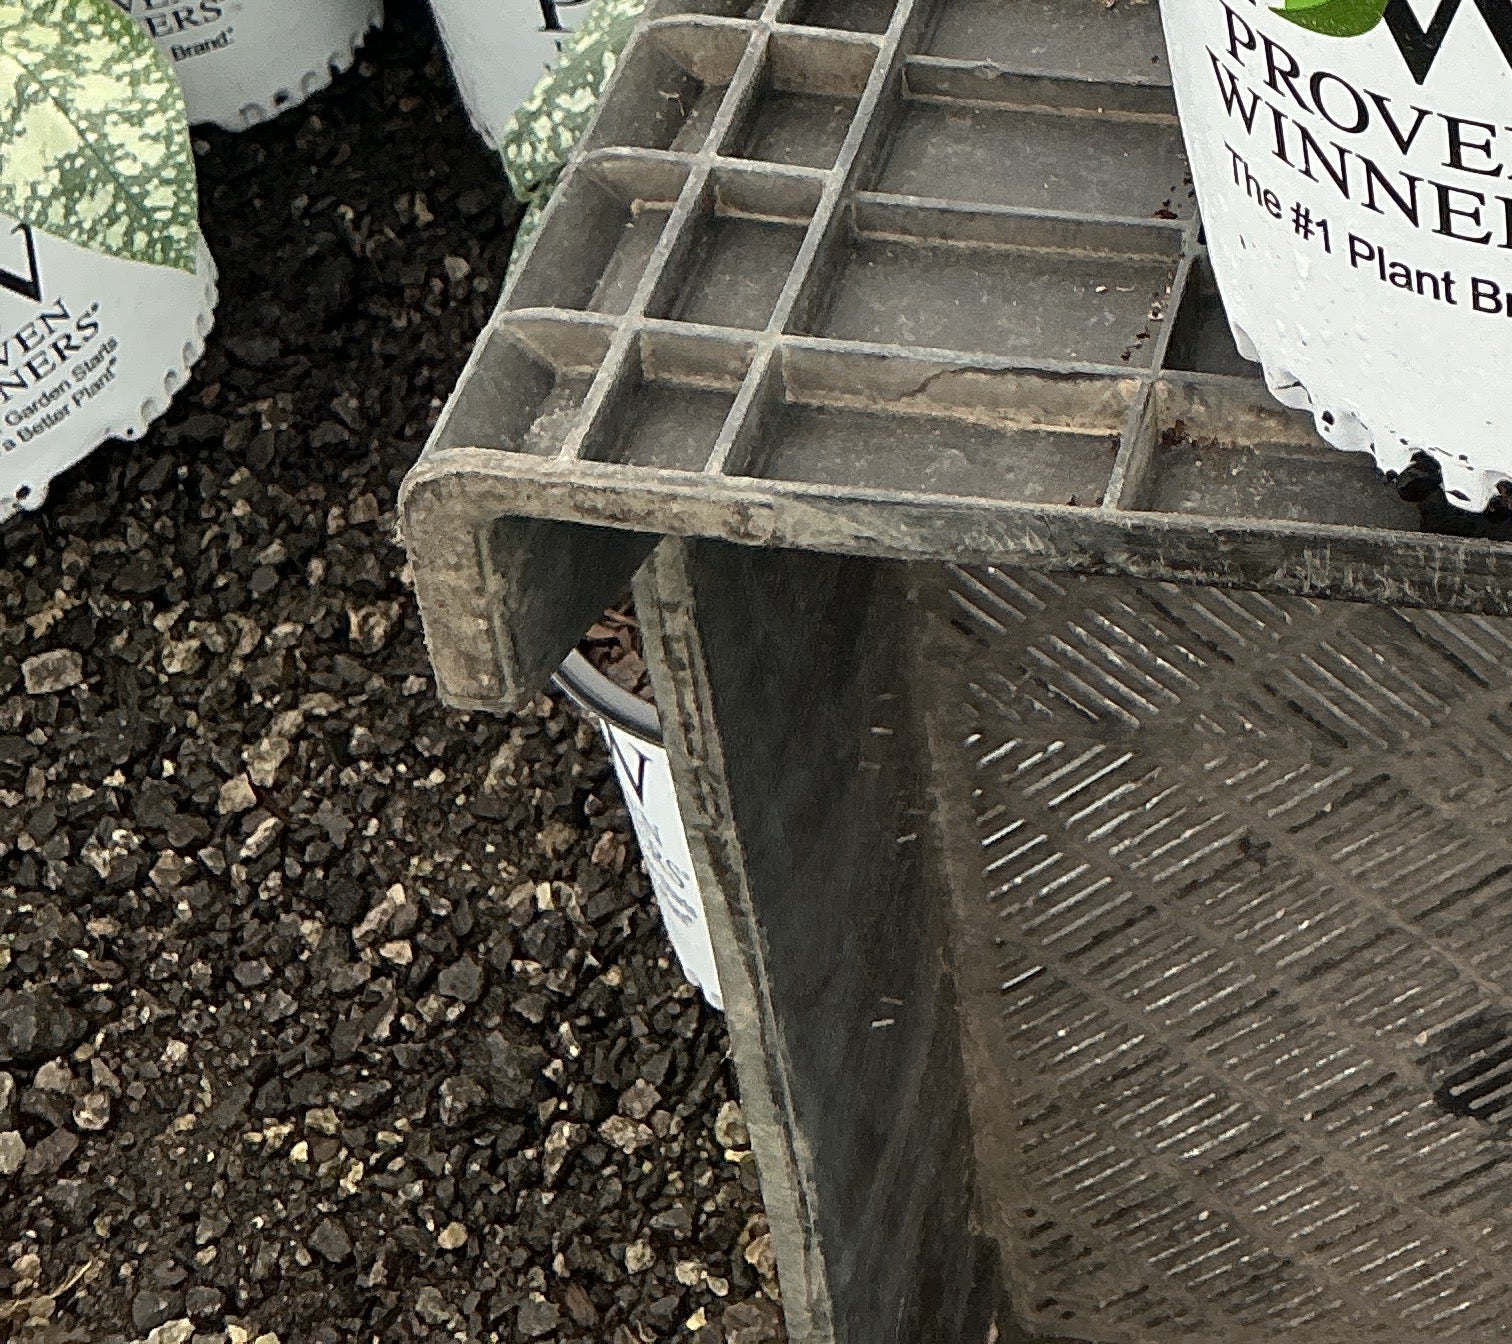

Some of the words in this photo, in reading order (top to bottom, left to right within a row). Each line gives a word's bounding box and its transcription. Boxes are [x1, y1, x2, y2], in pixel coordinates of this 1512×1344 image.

[1224, 140, 1282, 219] The
[1291, 202, 1332, 255] #1
[1348, 232, 1458, 305] Plant
